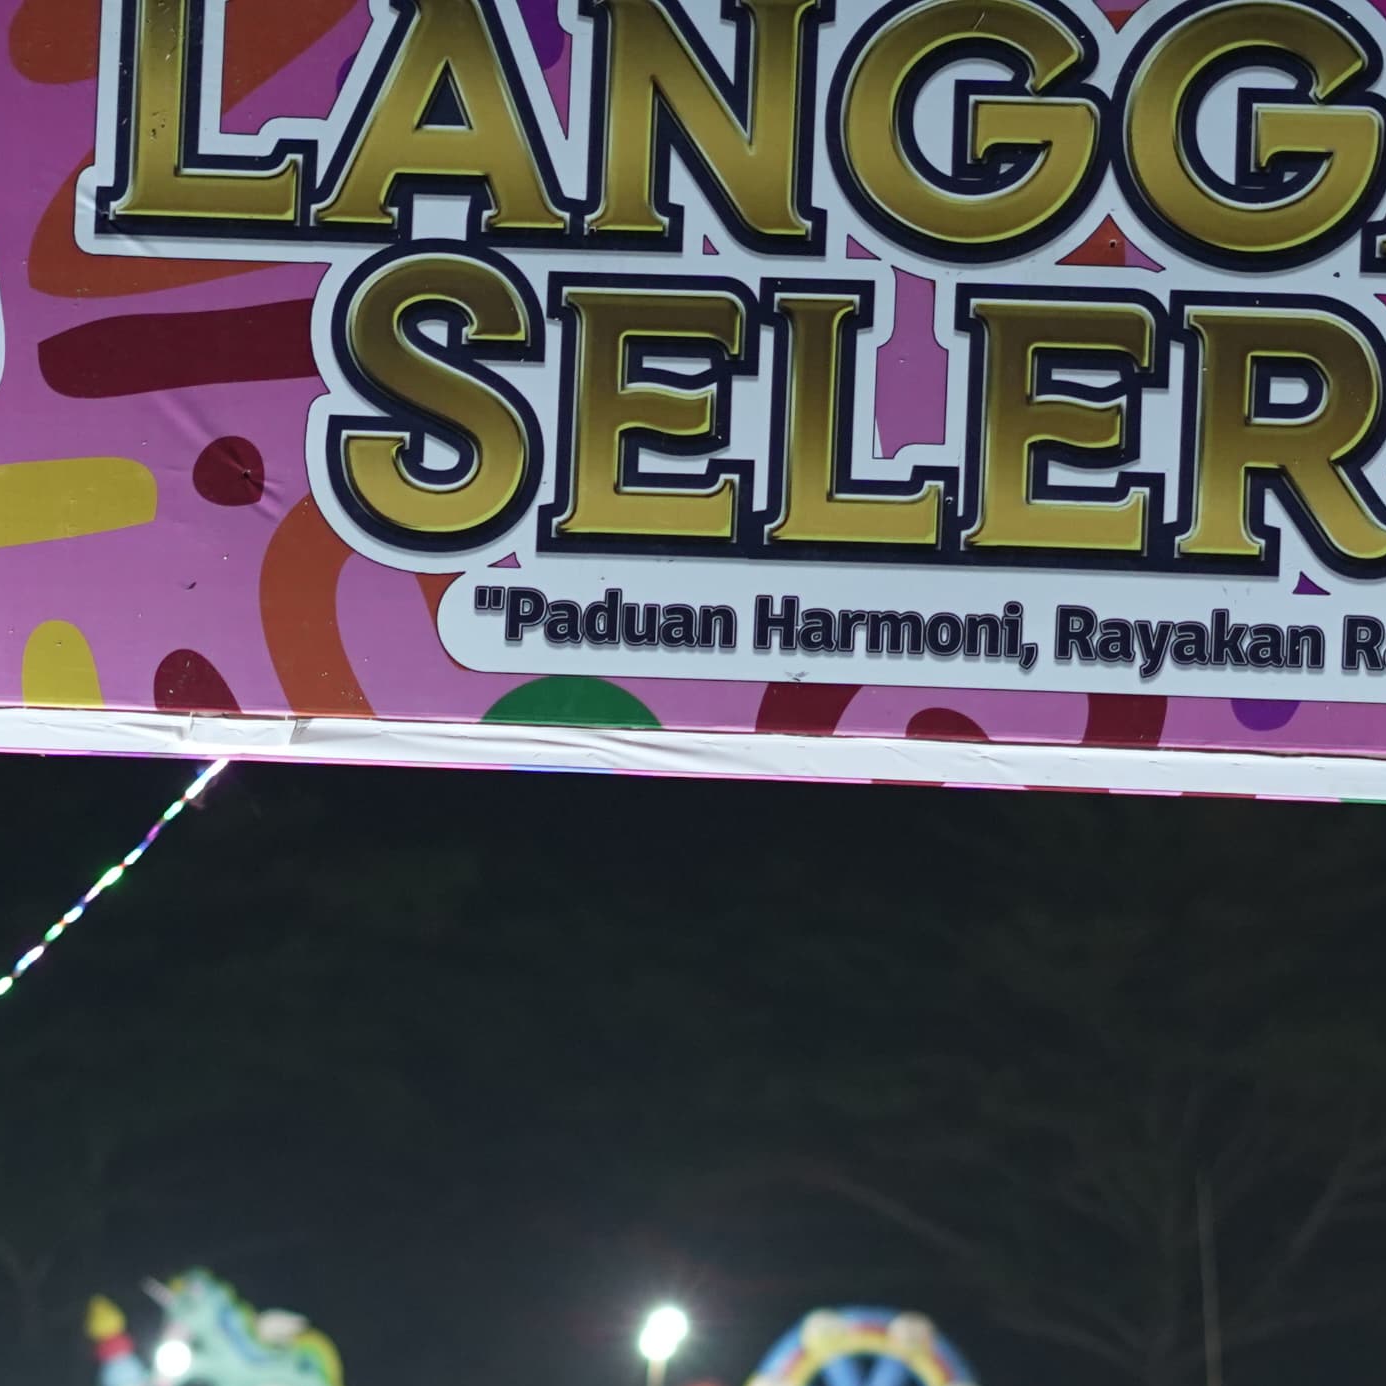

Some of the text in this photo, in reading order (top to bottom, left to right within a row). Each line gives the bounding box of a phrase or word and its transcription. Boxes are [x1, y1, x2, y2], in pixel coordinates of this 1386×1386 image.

[474, 586, 737, 652] "Paduan
[755, 594, 1038, 671] Harmoni,
[1054, 603, 1326, 679] Rayakan
